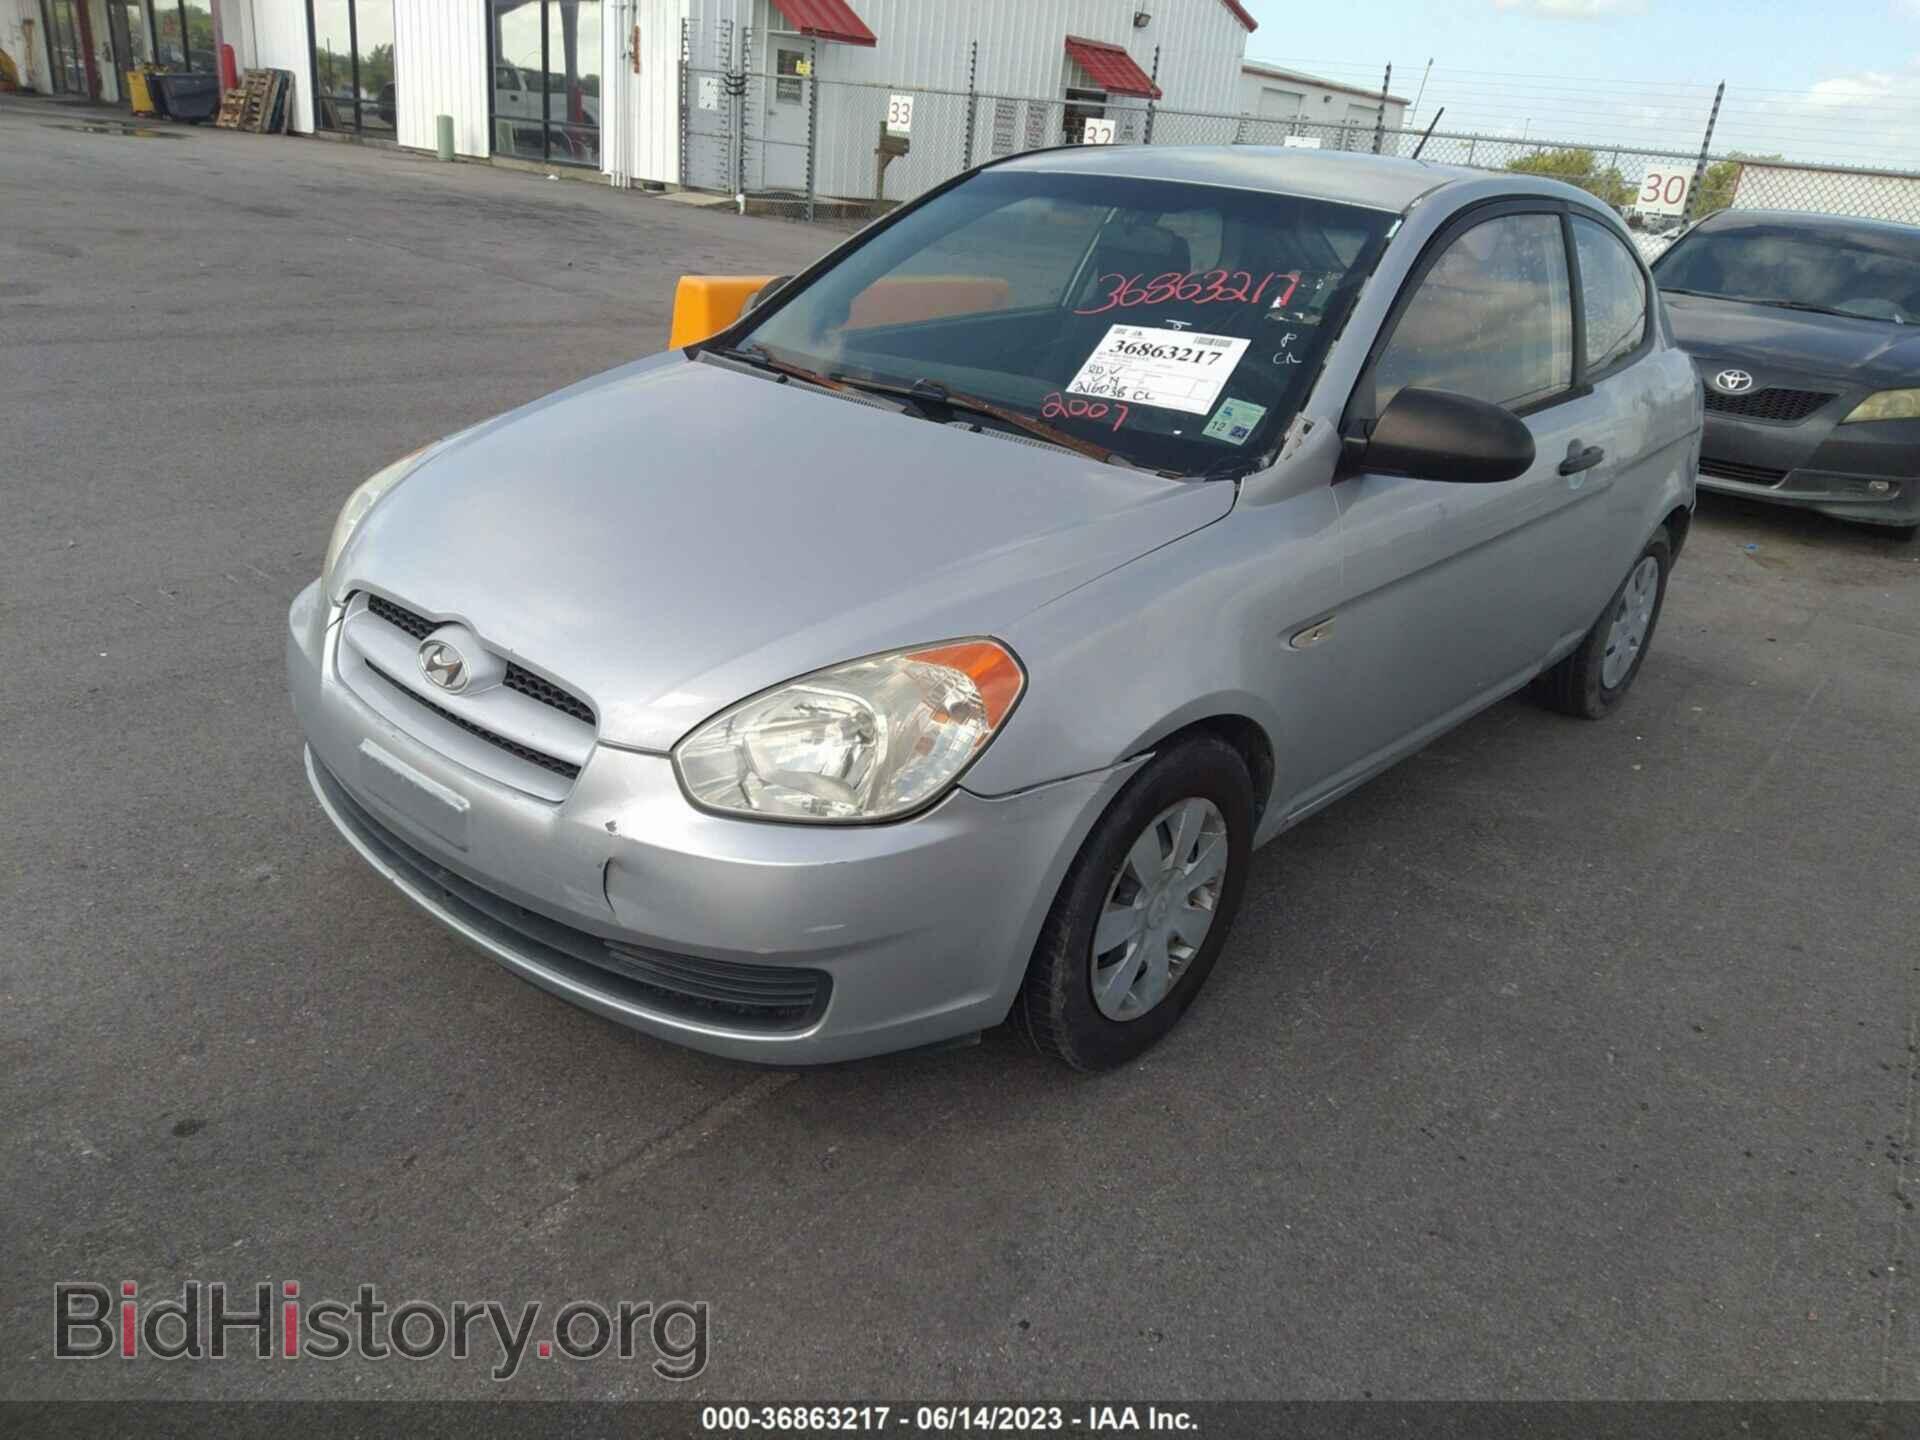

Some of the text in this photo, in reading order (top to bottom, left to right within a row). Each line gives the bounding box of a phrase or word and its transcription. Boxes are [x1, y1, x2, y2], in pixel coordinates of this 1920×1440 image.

[889, 102, 911, 124] 33
[1087, 126, 1112, 144] 32
[1641, 173, 1686, 205] 30
[1073, 270, 1300, 314] 36863217
[1108, 340, 1223, 366] 36863217
[1042, 391, 1129, 432] 2007
